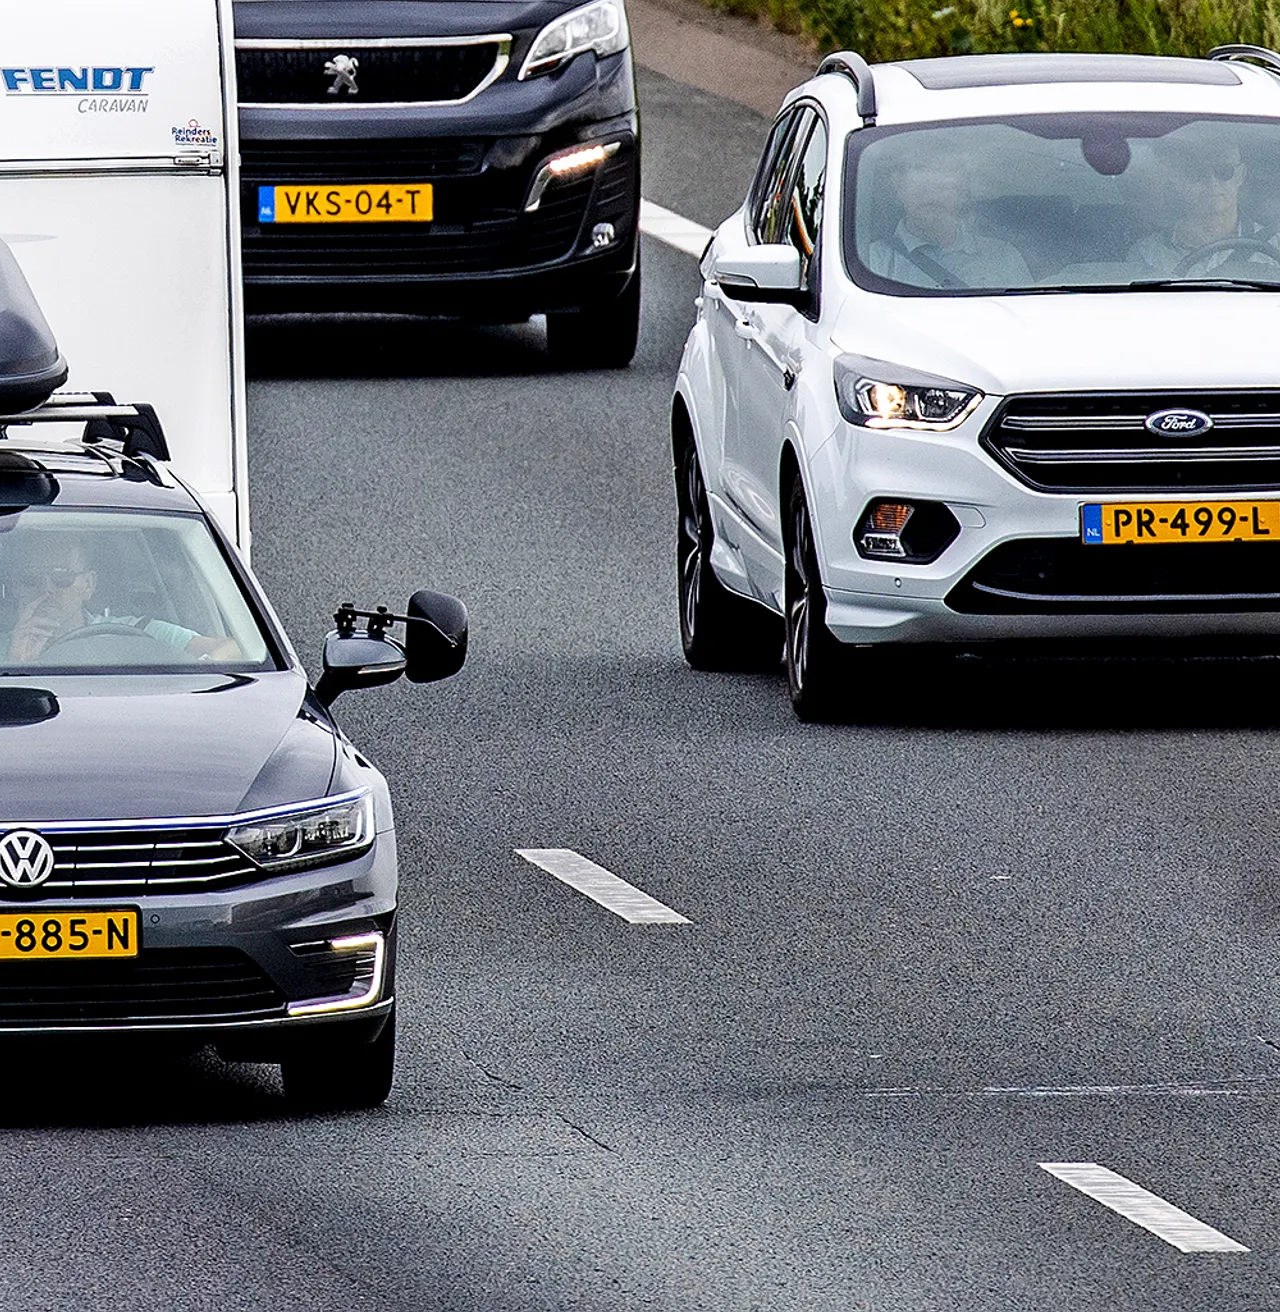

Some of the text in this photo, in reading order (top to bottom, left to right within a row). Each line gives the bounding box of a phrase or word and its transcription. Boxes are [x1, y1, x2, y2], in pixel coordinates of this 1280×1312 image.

[0, 67, 155, 92] FENDT
[77, 98, 149, 114] CARAVAN
[171, 127, 211, 136] Reinders
[175, 134, 218, 144] Rekreatie
[284, 190, 421, 216] VKS-04-T
[1160, 414, 1196, 430] Ford
[1086, 506, 1270, 538] NL PR-499-L
